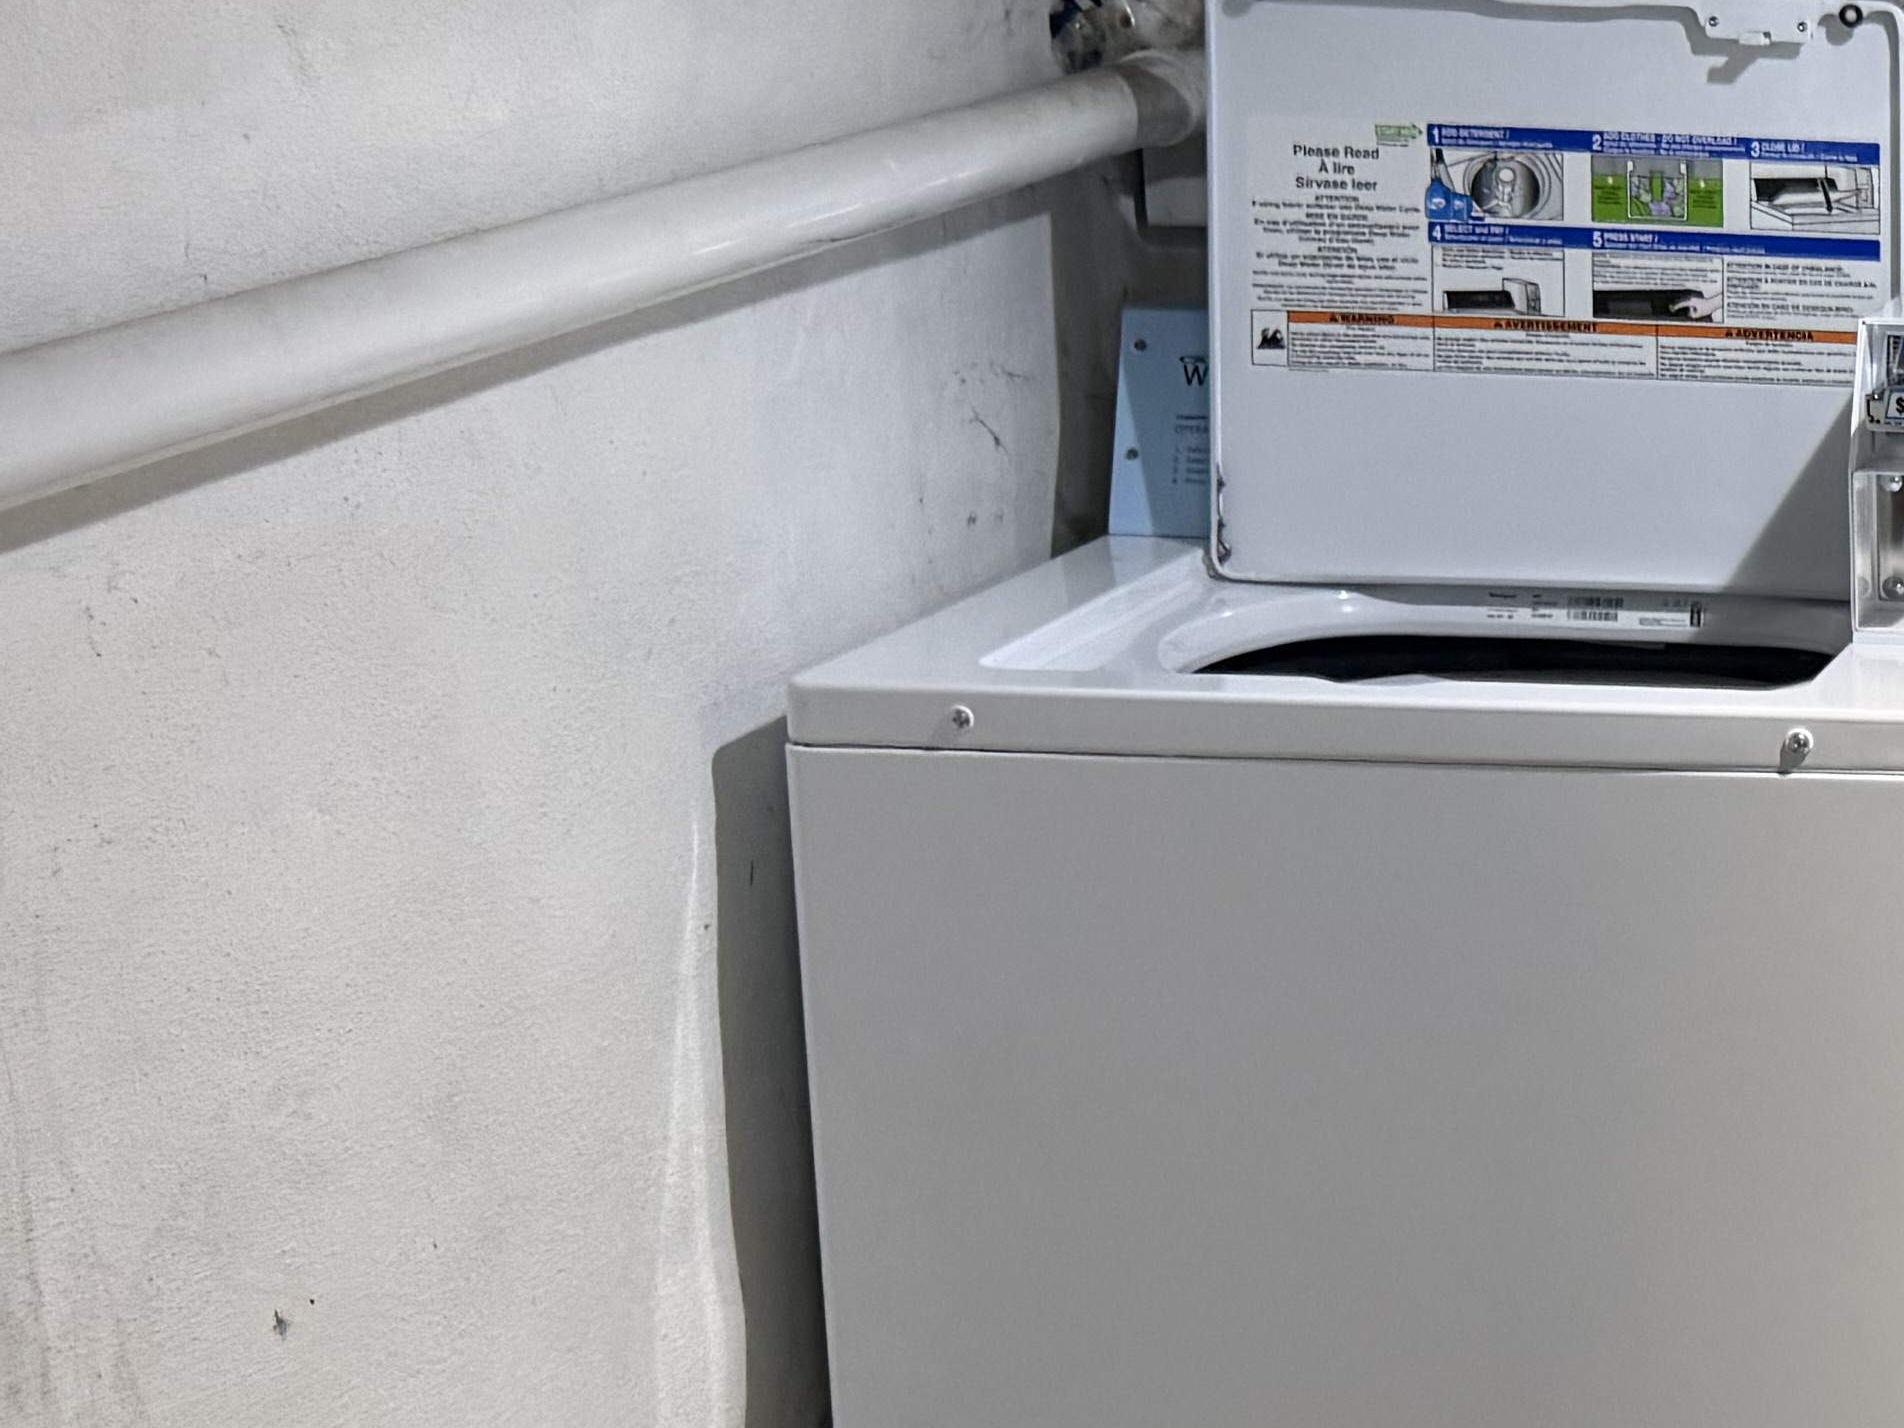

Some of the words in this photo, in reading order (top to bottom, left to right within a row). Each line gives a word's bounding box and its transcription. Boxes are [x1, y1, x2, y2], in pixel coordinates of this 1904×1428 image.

[1432, 127, 1440, 144] 1
[1592, 134, 1602, 151] 2
[1293, 144, 1340, 158] Please
[1344, 146, 1380, 160] Read
[1751, 141, 1760, 158] 3
[1318, 157, 1328, 173] À
[1333, 161, 1355, 175] lire
[1352, 178, 1378, 191] leer
[1432, 225, 1442, 241] 4
[1592, 232, 1602, 248] 5
